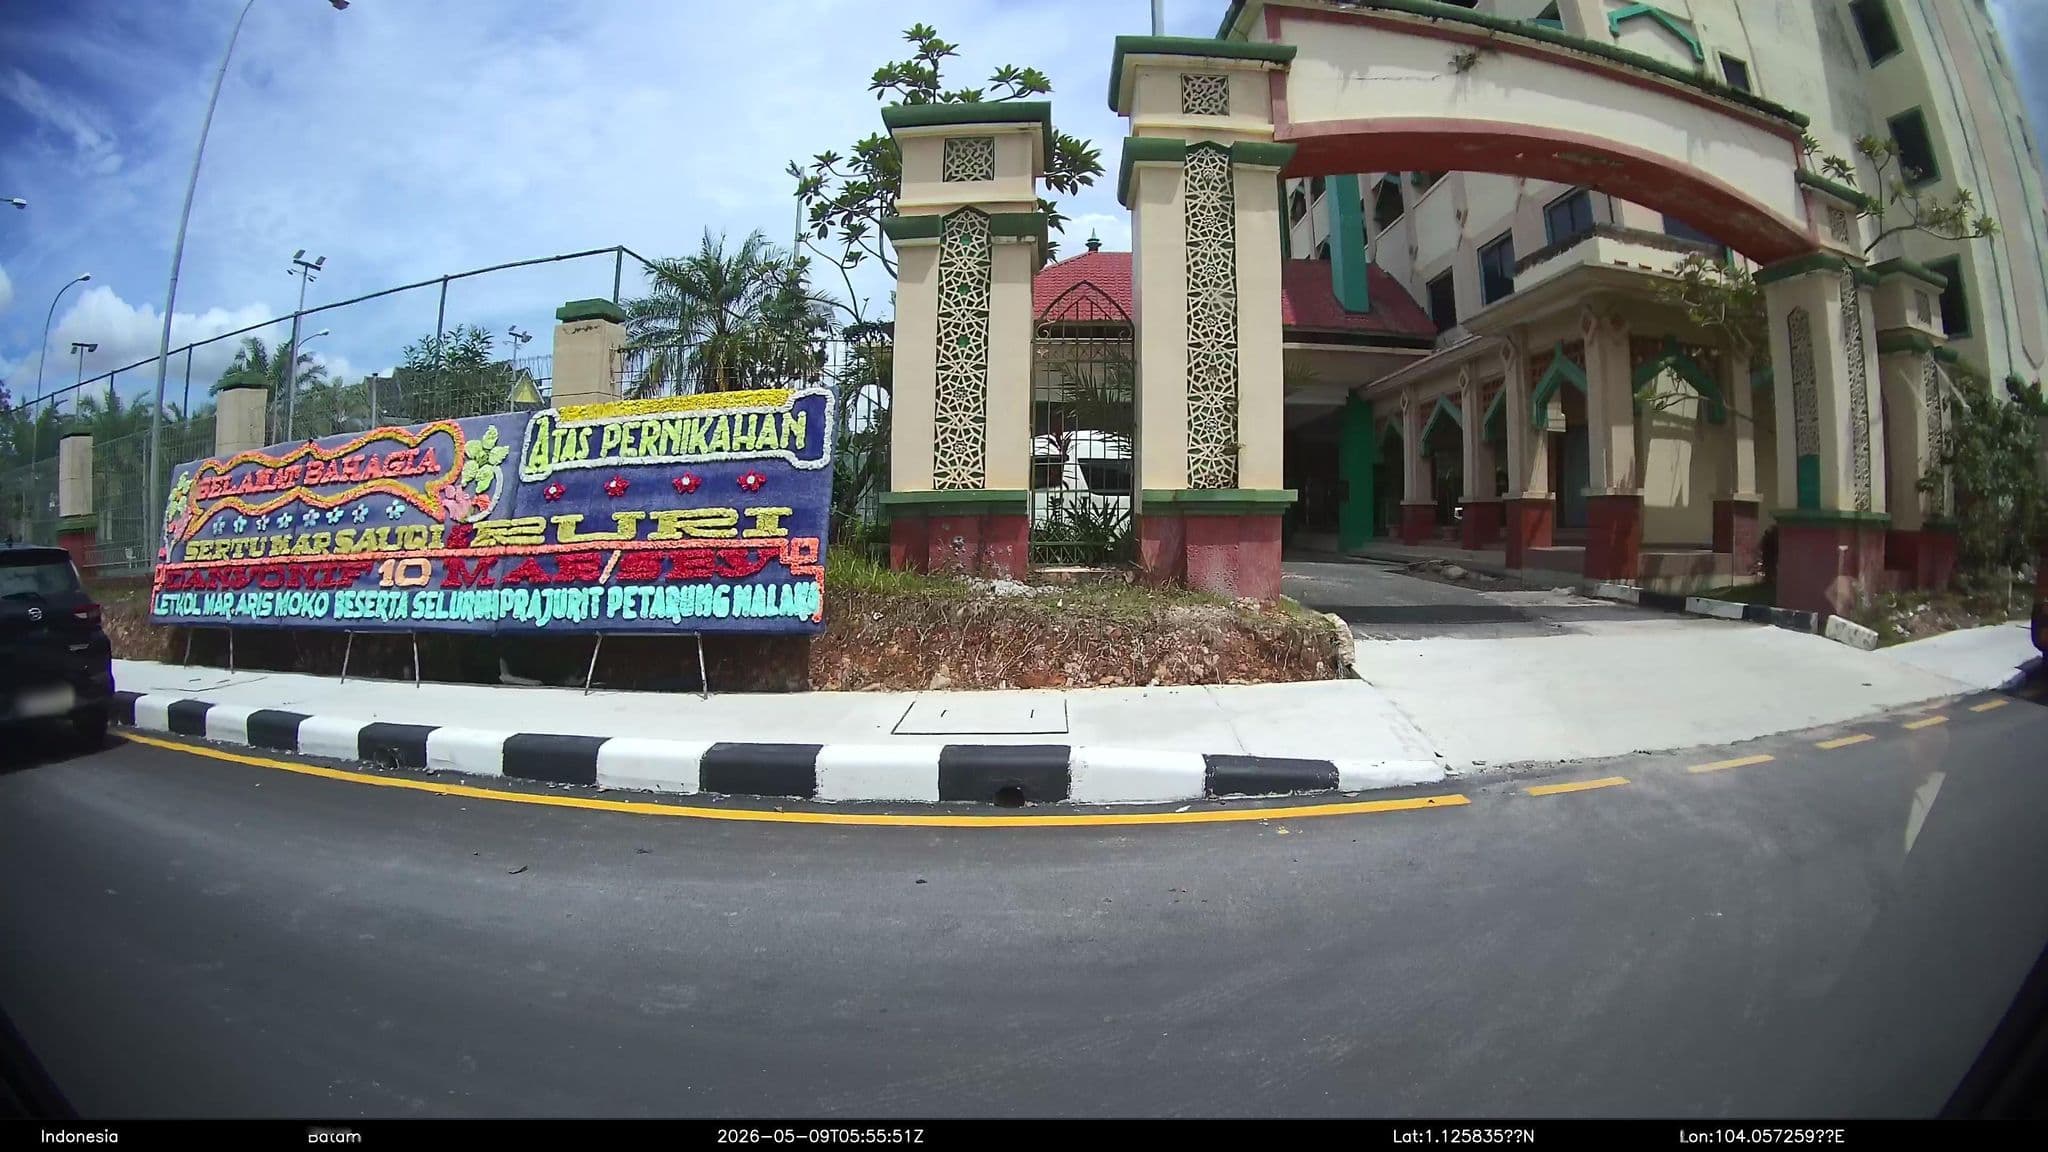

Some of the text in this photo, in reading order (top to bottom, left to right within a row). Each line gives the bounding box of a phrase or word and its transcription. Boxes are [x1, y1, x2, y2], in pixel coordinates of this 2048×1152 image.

[600, 410, 807, 458] PERNIKAHAN
[197, 446, 441, 499] SELAMAT BAHAGIA
[184, 536, 268, 562] SERTU
[269, 532, 332, 557] MAR
[333, 525, 445, 554] SAUQI
[471, 507, 793, 545] RURI
[378, 557, 432, 588] 10
[154, 592, 202, 617] LETKOL
[274, 590, 331, 619] MOKO
[334, 589, 408, 622] BESERTA
[500, 587, 605, 627] PRAJURIT
